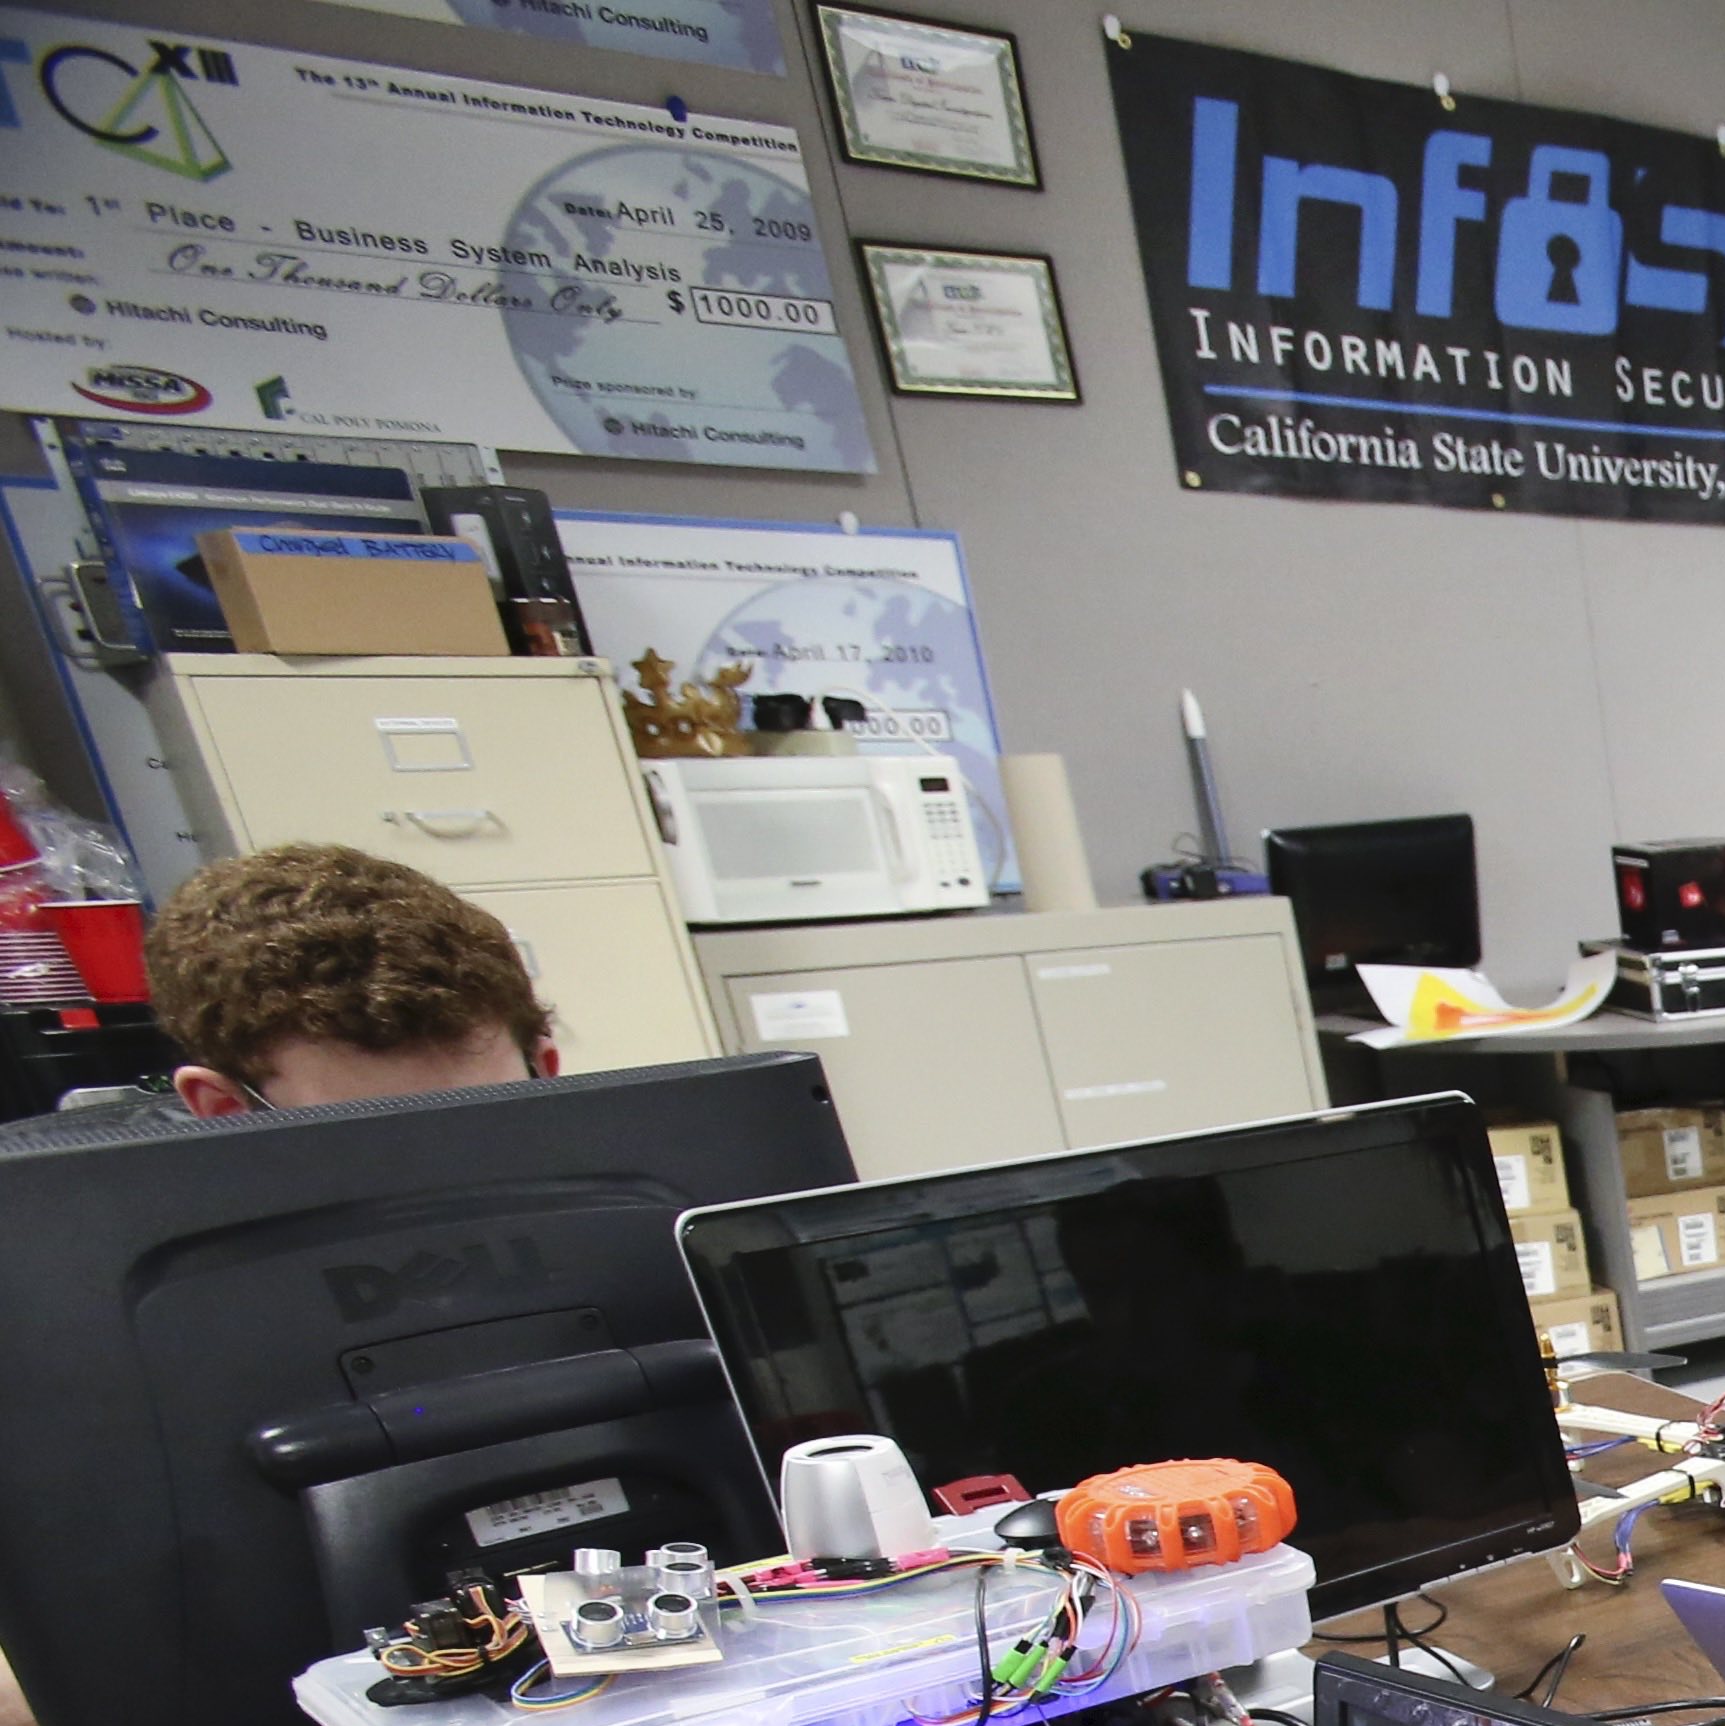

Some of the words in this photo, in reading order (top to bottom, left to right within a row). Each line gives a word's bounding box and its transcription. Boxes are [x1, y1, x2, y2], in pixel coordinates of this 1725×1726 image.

[599, 7, 709, 42] Consulting
[295, 67, 335, 86] The
[388, 81, 457, 104] Annual
[463, 94, 576, 123] Information
[581, 110, 687, 140] Technology
[693, 127, 798, 153] Competition
[145, 201, 236, 234] Place
[294, 218, 430, 257] Business
[449, 240, 552, 272] System
[574, 253, 682, 285] Analysis
[616, 201, 675, 228] April
[694, 210, 735, 236] 25,
[752, 217, 813, 243] 2009
[248, 251, 408, 296] Thousand
[417, 271, 533, 311] Dollars
[549, 285, 623, 325] Only
[666, 289, 686, 316] $
[698, 296, 820, 326] 1000.00
[106, 300, 191, 325] Hitachi
[199, 309, 328, 342] Consulting
[631, 421, 698, 441] Hitachi
[703, 427, 806, 450] Consulting
[1207, 412, 1422, 474] California
[1433, 432, 1526, 480] State
[567, 554, 613, 569] nnual
[617, 555, 721, 574] Information
[725, 560, 821, 579] Technology
[824, 565, 920, 581] Competition
[771, 640, 825, 663] April
[883, 644, 935, 665] 2010
[322, 1236, 564, 1324] DELL
